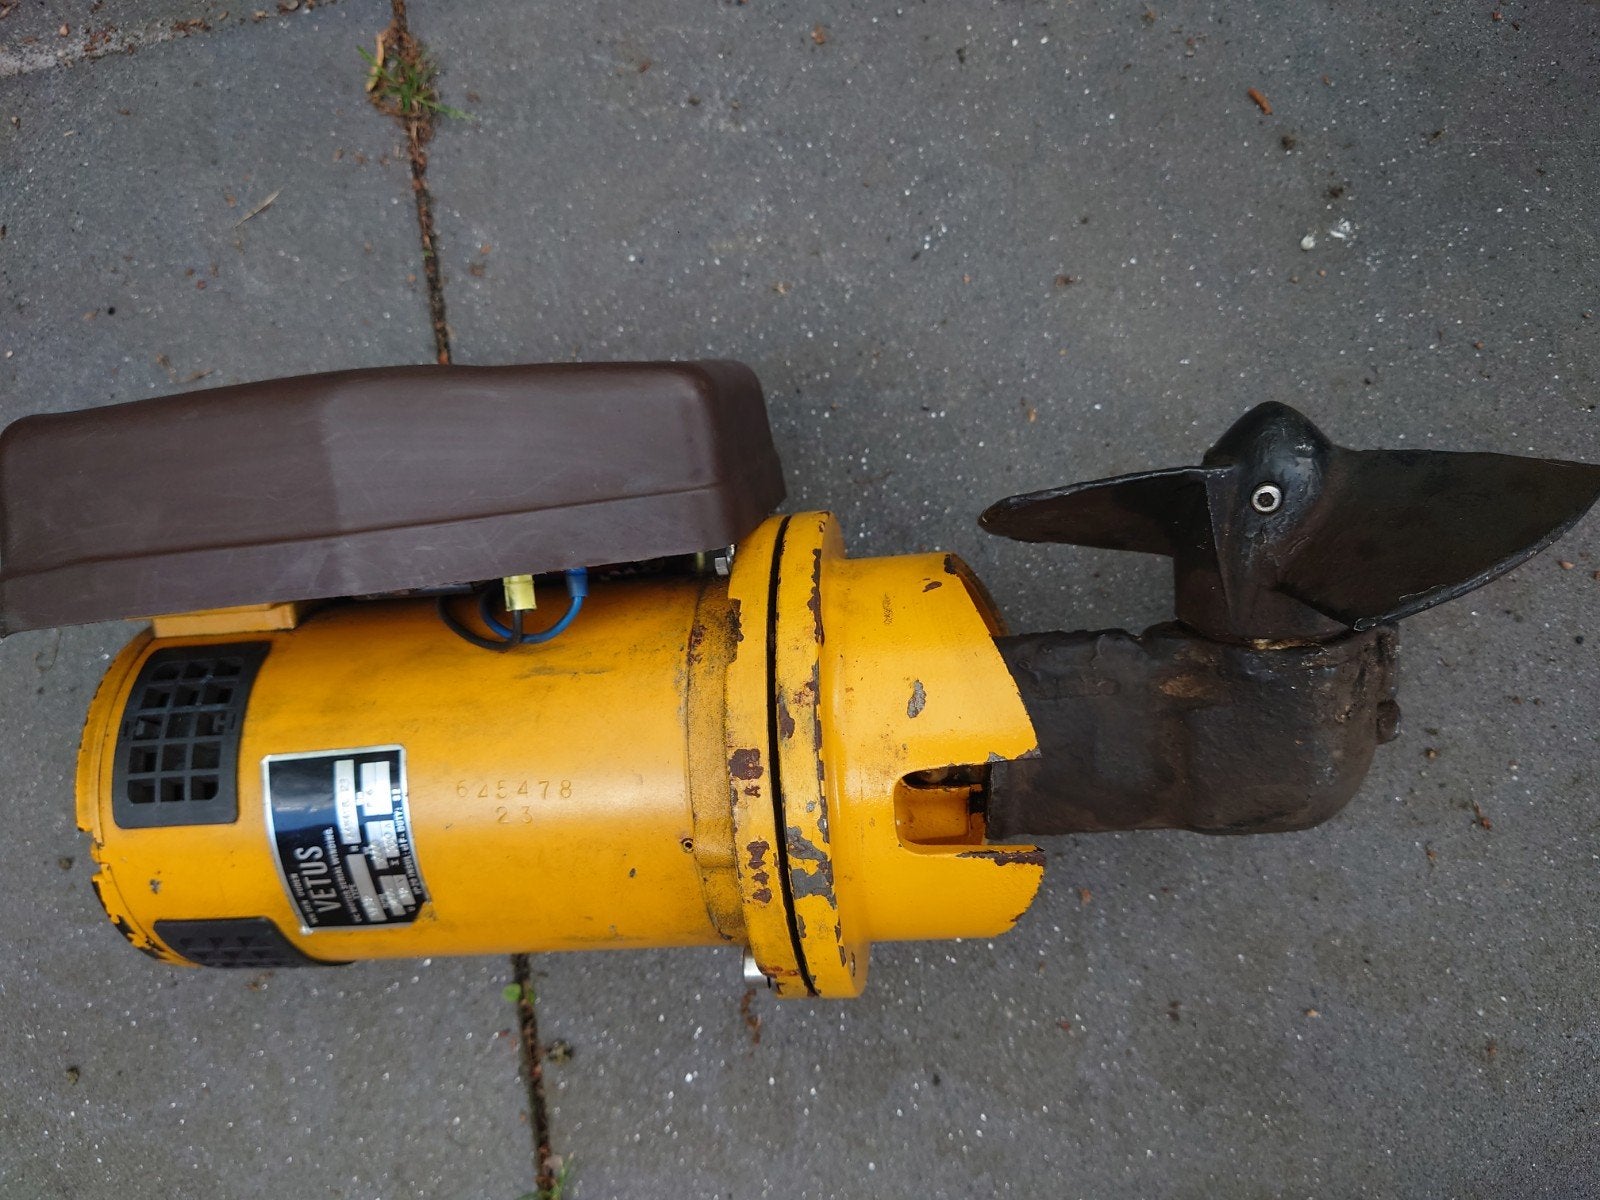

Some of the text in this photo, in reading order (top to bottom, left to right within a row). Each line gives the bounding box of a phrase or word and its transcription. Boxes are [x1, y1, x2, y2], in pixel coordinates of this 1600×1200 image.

[456, 779, 572, 801] 645478
[496, 806, 533, 825] 23
[293, 846, 342, 913] VETUS
[334, 865, 348, 890] SERIAL
